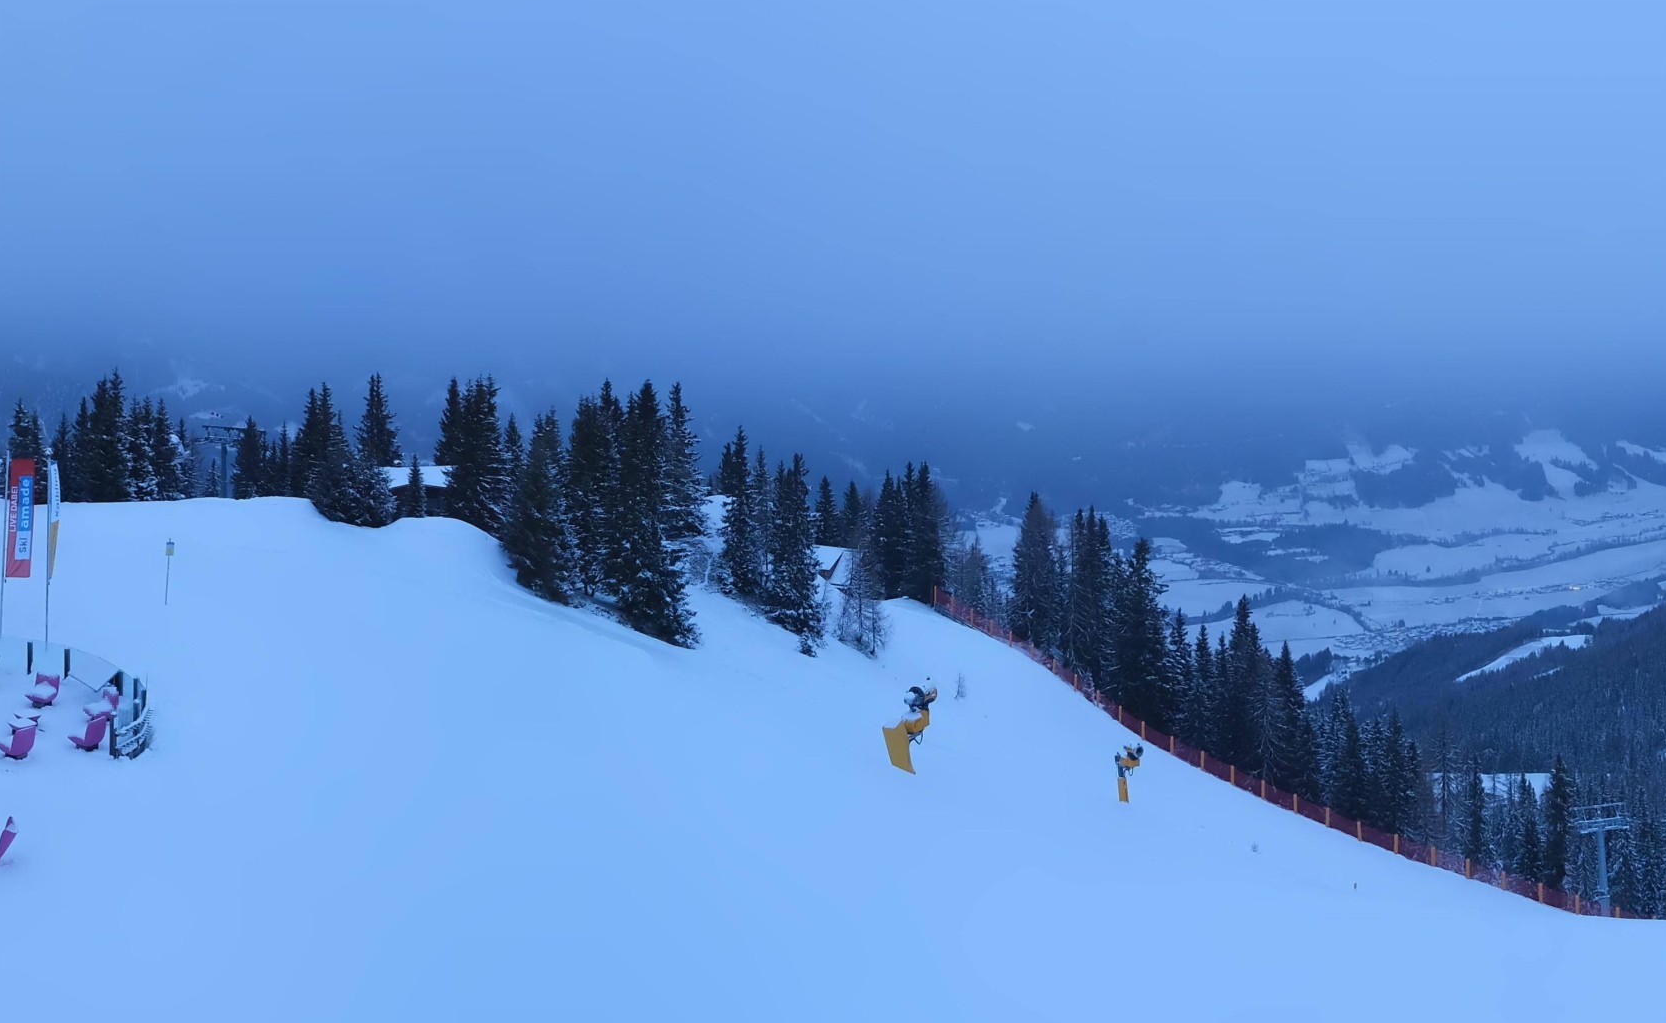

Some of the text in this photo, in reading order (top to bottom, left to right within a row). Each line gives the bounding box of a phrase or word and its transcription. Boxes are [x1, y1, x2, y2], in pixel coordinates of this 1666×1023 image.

[9, 486, 18, 533] LIVE DABEI
[19, 537, 27, 553] Ski
